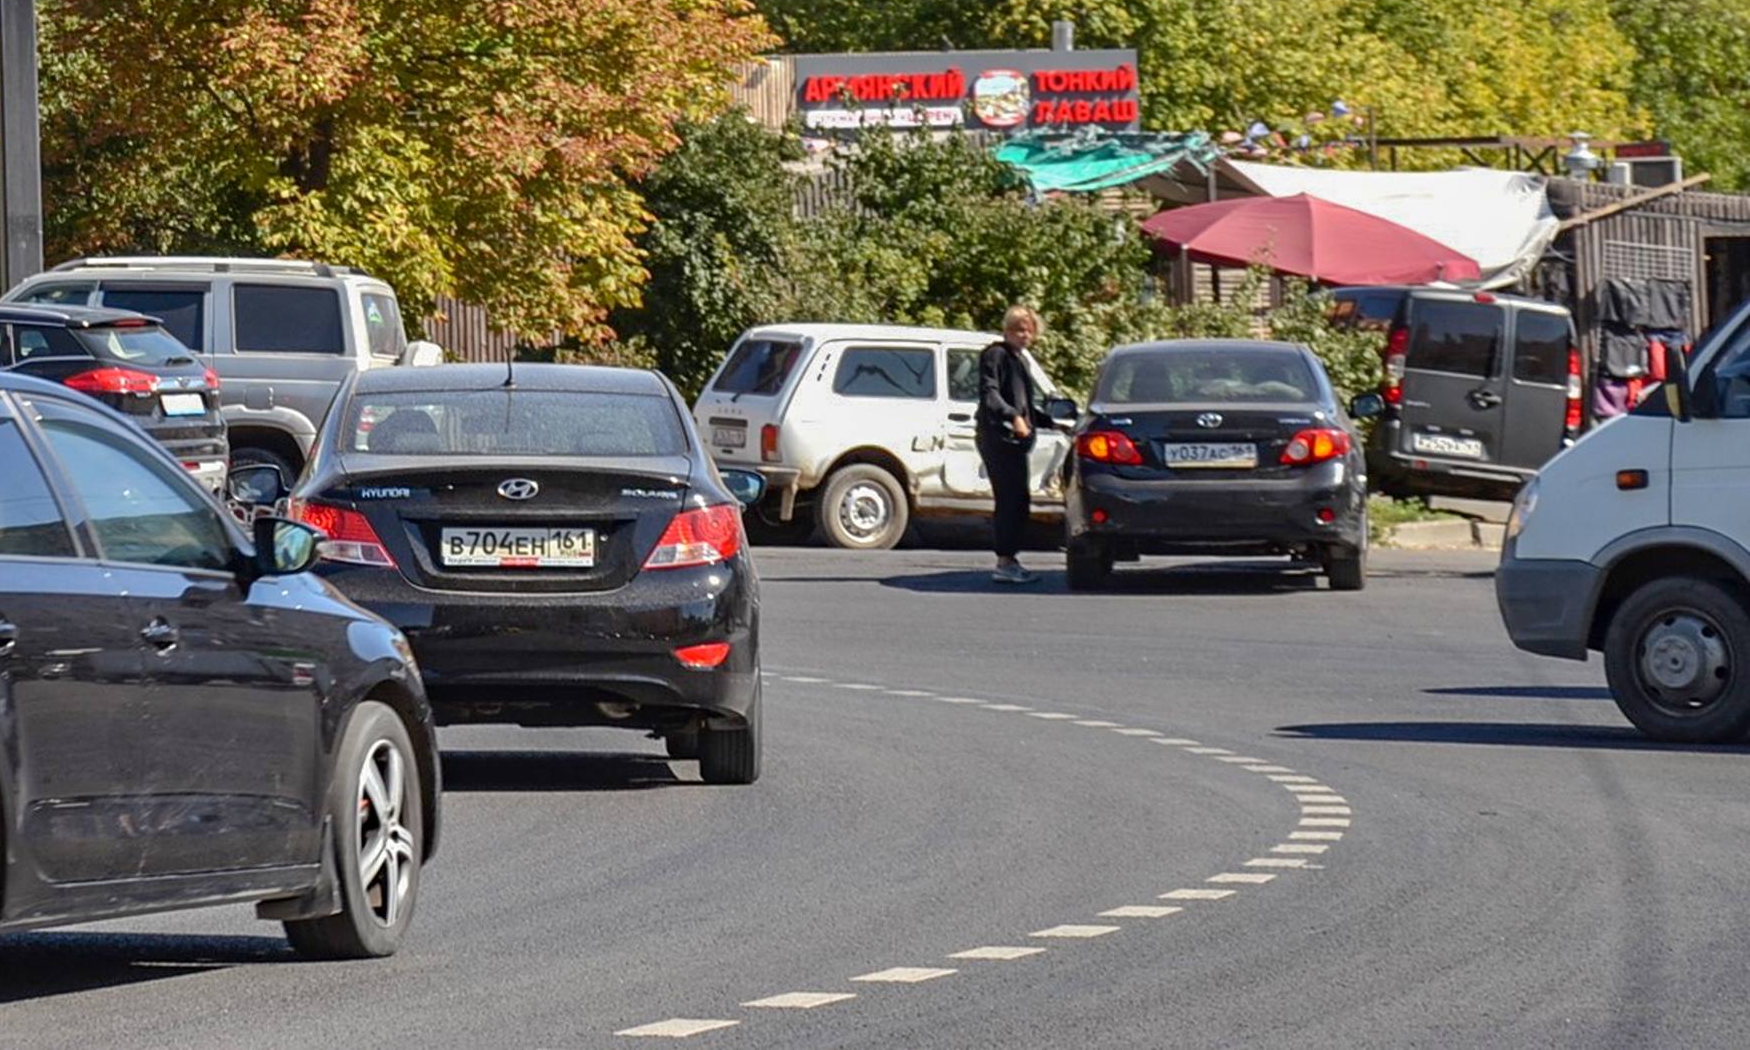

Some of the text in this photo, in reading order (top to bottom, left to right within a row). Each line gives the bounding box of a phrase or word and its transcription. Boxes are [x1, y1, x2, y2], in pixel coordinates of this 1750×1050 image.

[1033, 62, 1137, 92] ТОНКИЙ
[1034, 99, 1138, 123] ЛАВАШ
[361, 488, 411, 499] HYUNDAI
[552, 530, 588, 550] 161
